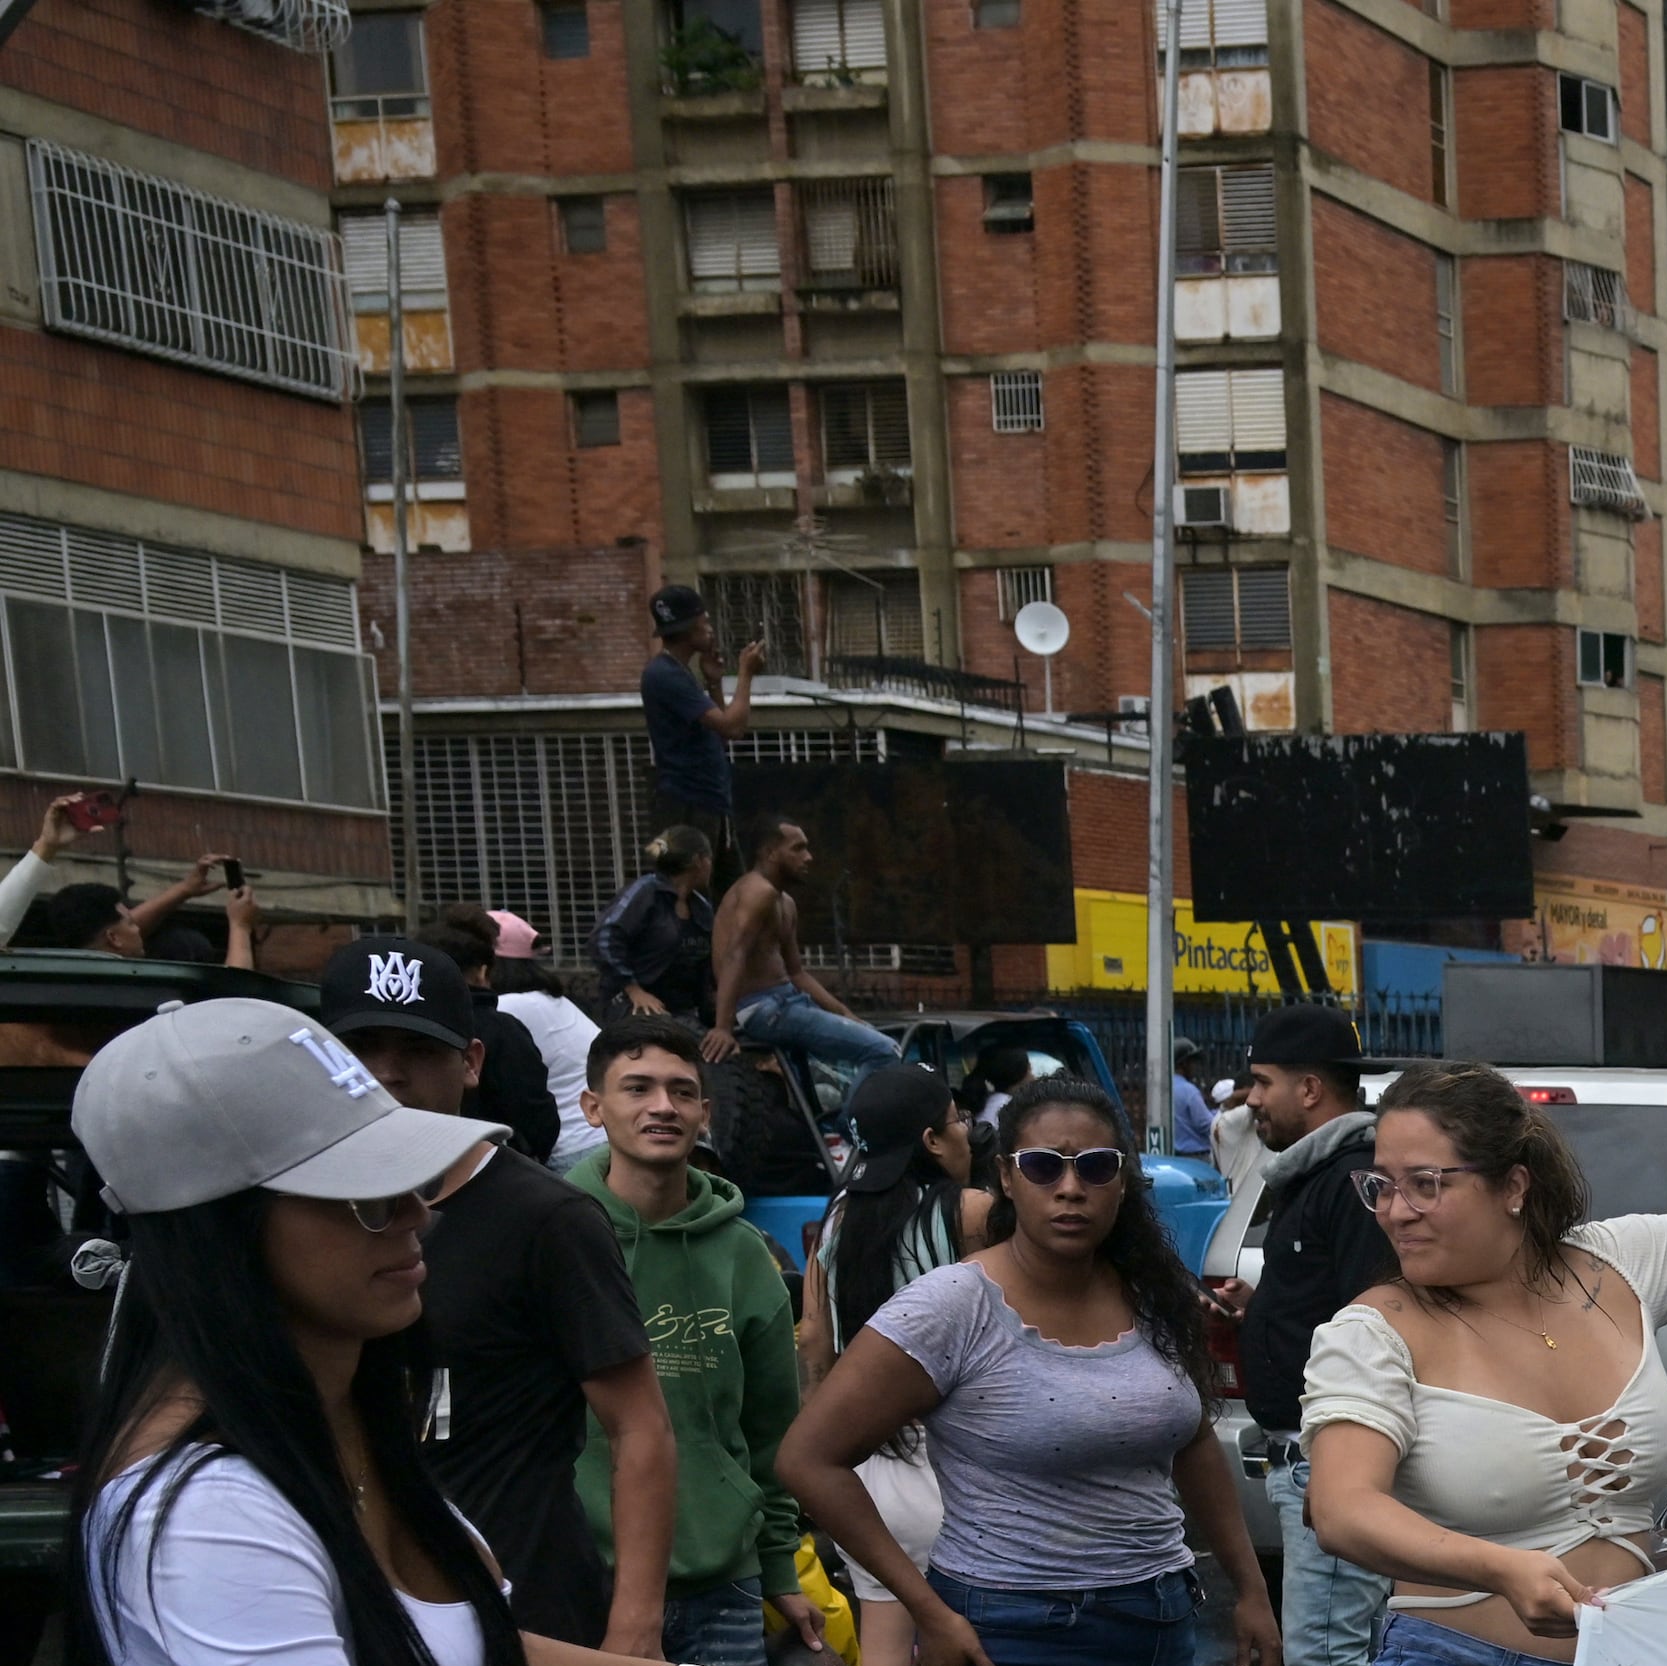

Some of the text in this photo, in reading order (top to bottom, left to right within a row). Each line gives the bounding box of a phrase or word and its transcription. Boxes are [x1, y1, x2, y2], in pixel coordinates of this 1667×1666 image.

[1550, 903, 1580, 926] MAYOR
[1174, 930, 1270, 973] Pintacasa
[288, 1027, 379, 1099] LA
